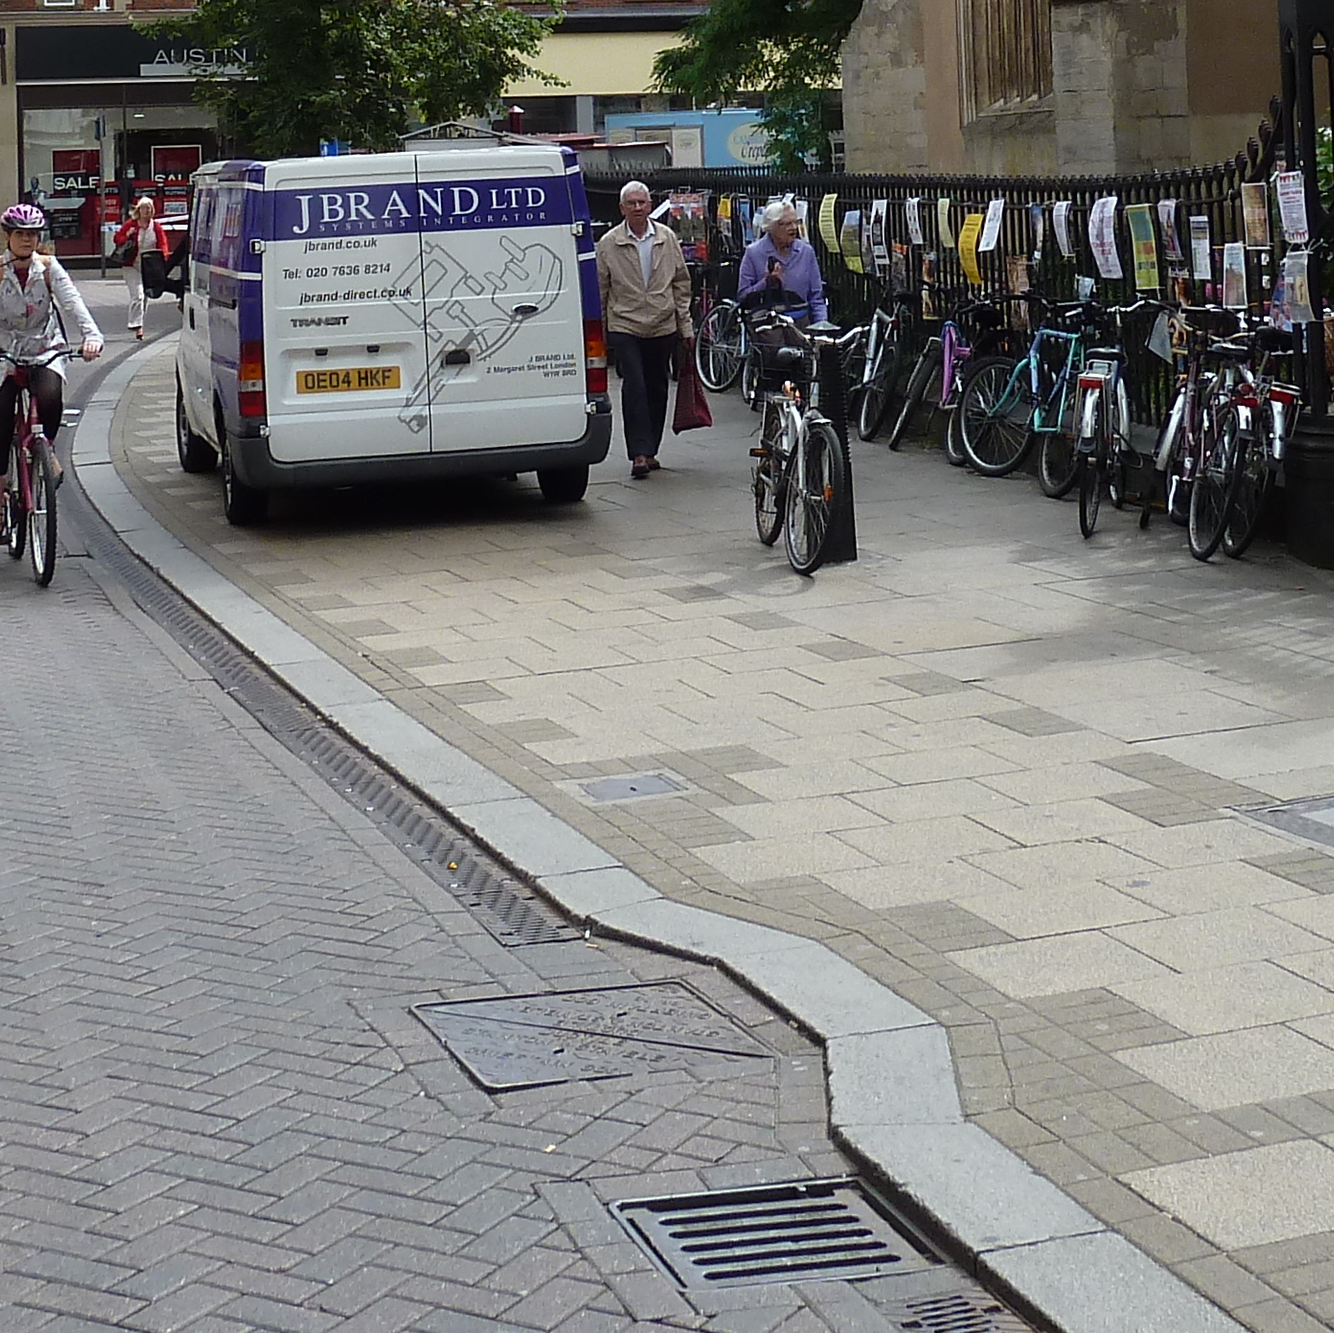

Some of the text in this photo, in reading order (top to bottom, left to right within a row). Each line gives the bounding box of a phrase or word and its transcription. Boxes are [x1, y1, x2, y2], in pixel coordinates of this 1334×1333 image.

[153, 47, 247, 66] AUSTIN
[54, 176, 101, 190] SALE
[488, 187, 547, 210] LTD
[318, 211, 547, 233] SYSTEMS INTEGRATOR
[303, 237, 378, 254] jbrand.co.uk
[282, 263, 391, 280] Tel: 020 7636 8214
[299, 286, 413, 306] jbrand-direct.co.uk
[290, 315, 350, 328] TRANSIT
[527, 363, 549, 371] Street
[304, 368, 392, 390] OE04 HKF
